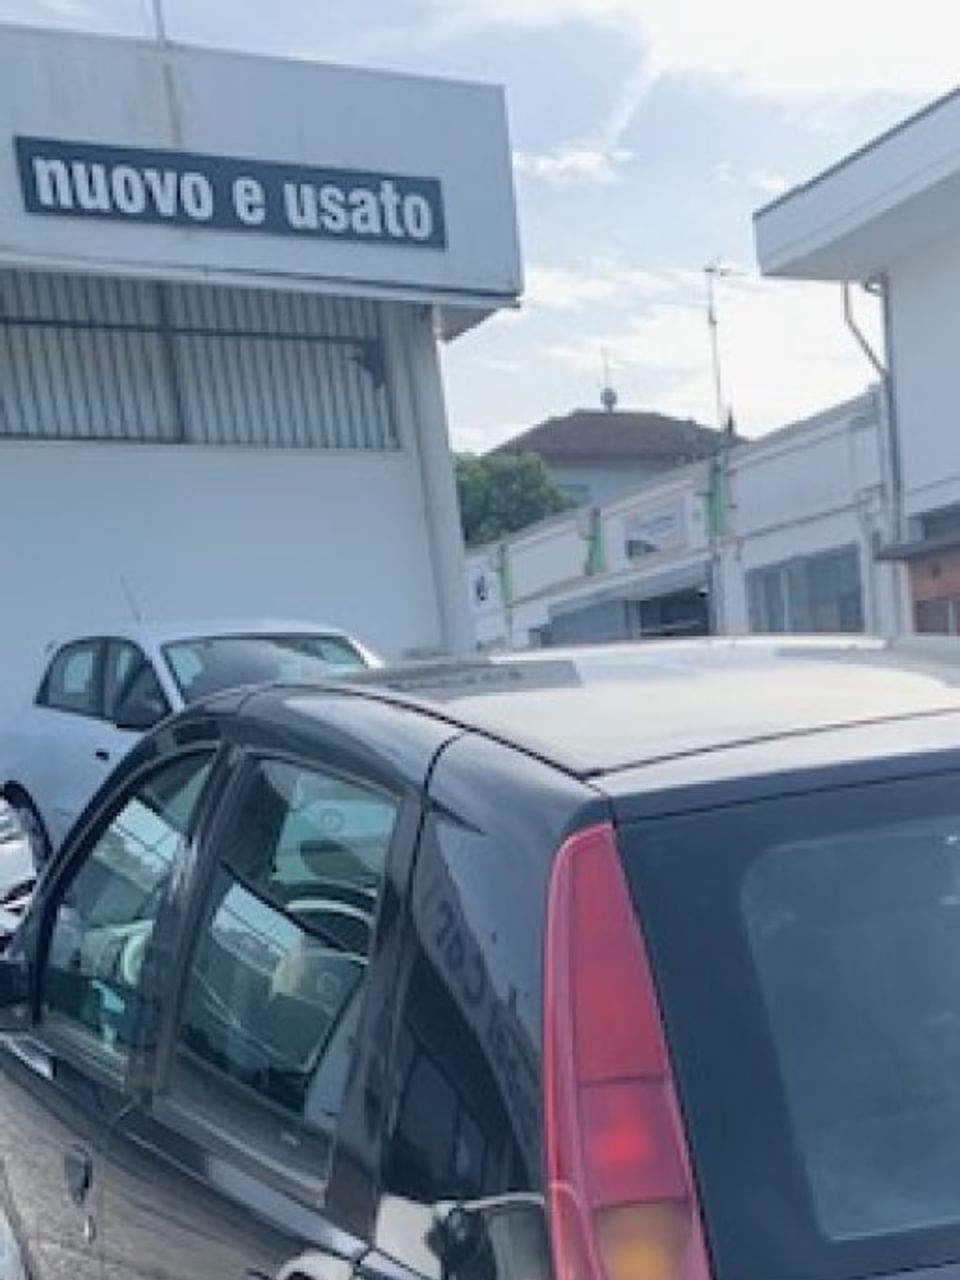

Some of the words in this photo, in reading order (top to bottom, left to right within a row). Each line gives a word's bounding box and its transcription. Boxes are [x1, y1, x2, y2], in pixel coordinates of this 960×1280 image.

[32, 156, 214, 223] nuovo
[232, 175, 266, 226] e
[283, 179, 434, 240] usato
